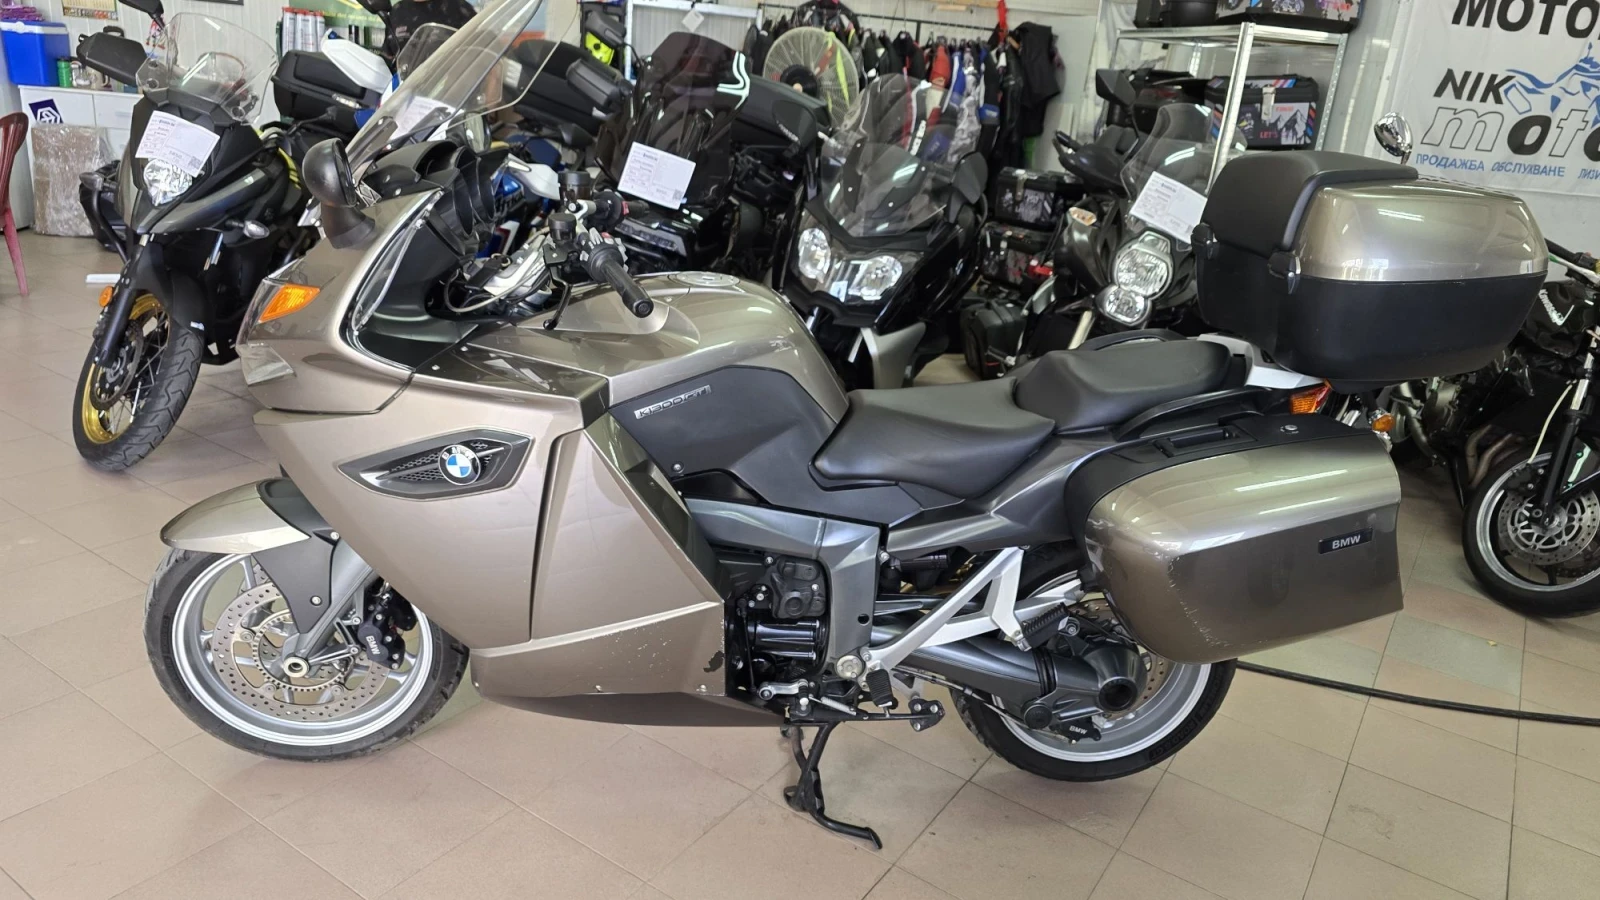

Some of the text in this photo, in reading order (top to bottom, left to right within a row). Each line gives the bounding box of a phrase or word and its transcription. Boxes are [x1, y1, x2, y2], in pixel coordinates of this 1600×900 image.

[1451, 0, 1600, 40] MOTO
[1433, 68, 1516, 105] NIK
[1415, 153, 1485, 172] ПРОДАЖБА
[1331, 535, 1361, 549] BMW
[365, 635, 381, 655] BMW
[1069, 725, 1088, 735] BMW
